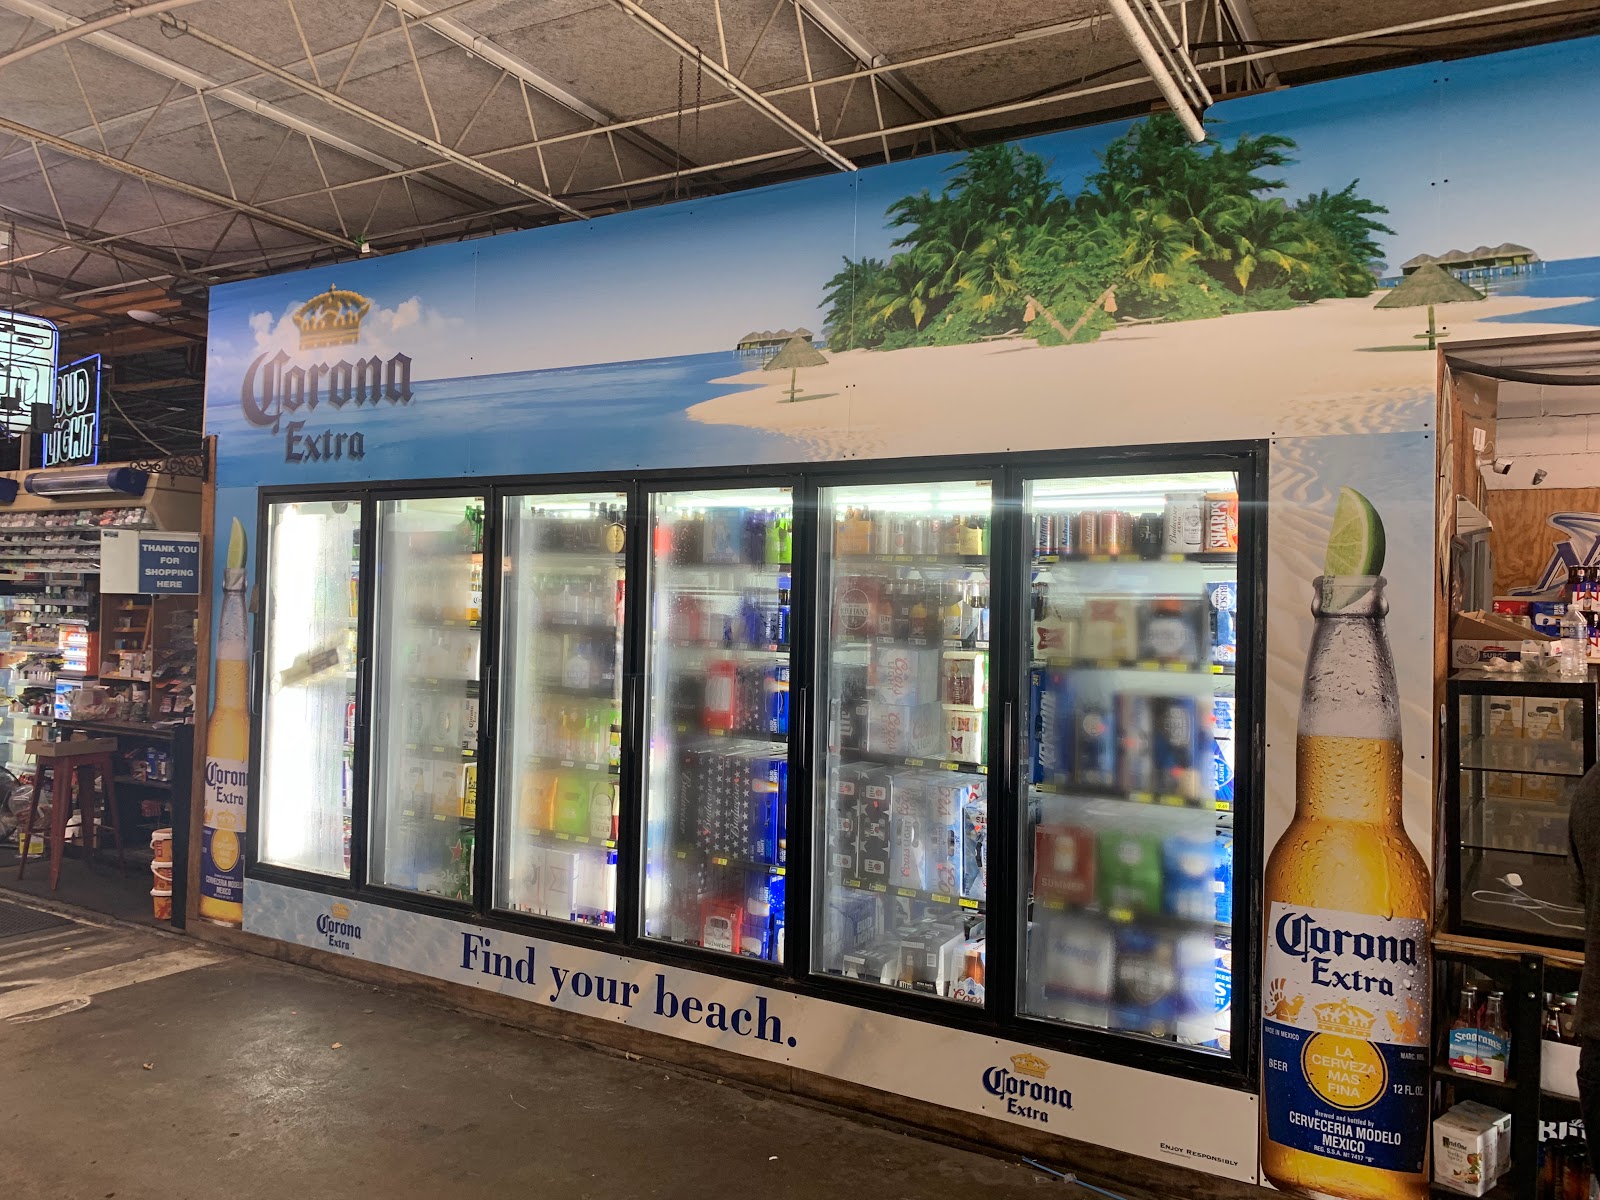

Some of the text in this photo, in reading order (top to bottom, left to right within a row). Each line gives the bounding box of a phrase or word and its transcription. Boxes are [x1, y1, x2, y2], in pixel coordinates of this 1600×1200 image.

[56, 369, 90, 418] BUD
[242, 349, 413, 434] Corona
[46, 413, 95, 466] LIGHT
[285, 420, 365, 463] Extra
[1040, 515, 1048, 546] Natural
[894, 658, 908, 695] Coors
[886, 713, 900, 752] Coors
[216, 786, 244, 805] Extra
[703, 778, 712, 834] Budweiser
[729, 782, 740, 839] Budweiser
[901, 848, 910, 877] Coors
[216, 886, 232, 895] MEXICO
[316, 914, 362, 940] Corona
[854, 926, 875, 946] LIGHT
[857, 917, 872, 933] BUD
[328, 934, 350, 950] Extra
[1276, 913, 1418, 966] Corona
[1311, 956, 1394, 996] Extra
[460, 932, 797, 1048] Find your beach.
[1280, 1030, 1299, 1041] MEXICO
[1455, 1032, 1501, 1050] Seagram's
[1312, 1054, 1376, 1075] CERVEZA
[1335, 1046, 1353, 1058] LA
[1268, 1058, 1288, 1072] BEER
[1328, 1070, 1360, 1085] MAS
[982, 1066, 1073, 1110] Corona
[1328, 1083, 1360, 1098] FINA
[1393, 1084, 1402, 1094] 12
[1404, 1085, 1414, 1095] FL.
[1006, 1098, 1048, 1123] Extra
[1315, 1109, 1334, 1120] Brewed
[1347, 1115, 1366, 1126] bottled
[1289, 1110, 1401, 1145] CERVECERIA MODELO
[1160, 1142, 1184, 1154] ENJOY
[1186, 1149, 1239, 1167] RESPONSIBLY
[1314, 1144, 1325, 1152] REG.
[1327, 1147, 1341, 1156] S.S.A.
[1322, 1133, 1365, 1154] MEXICO
